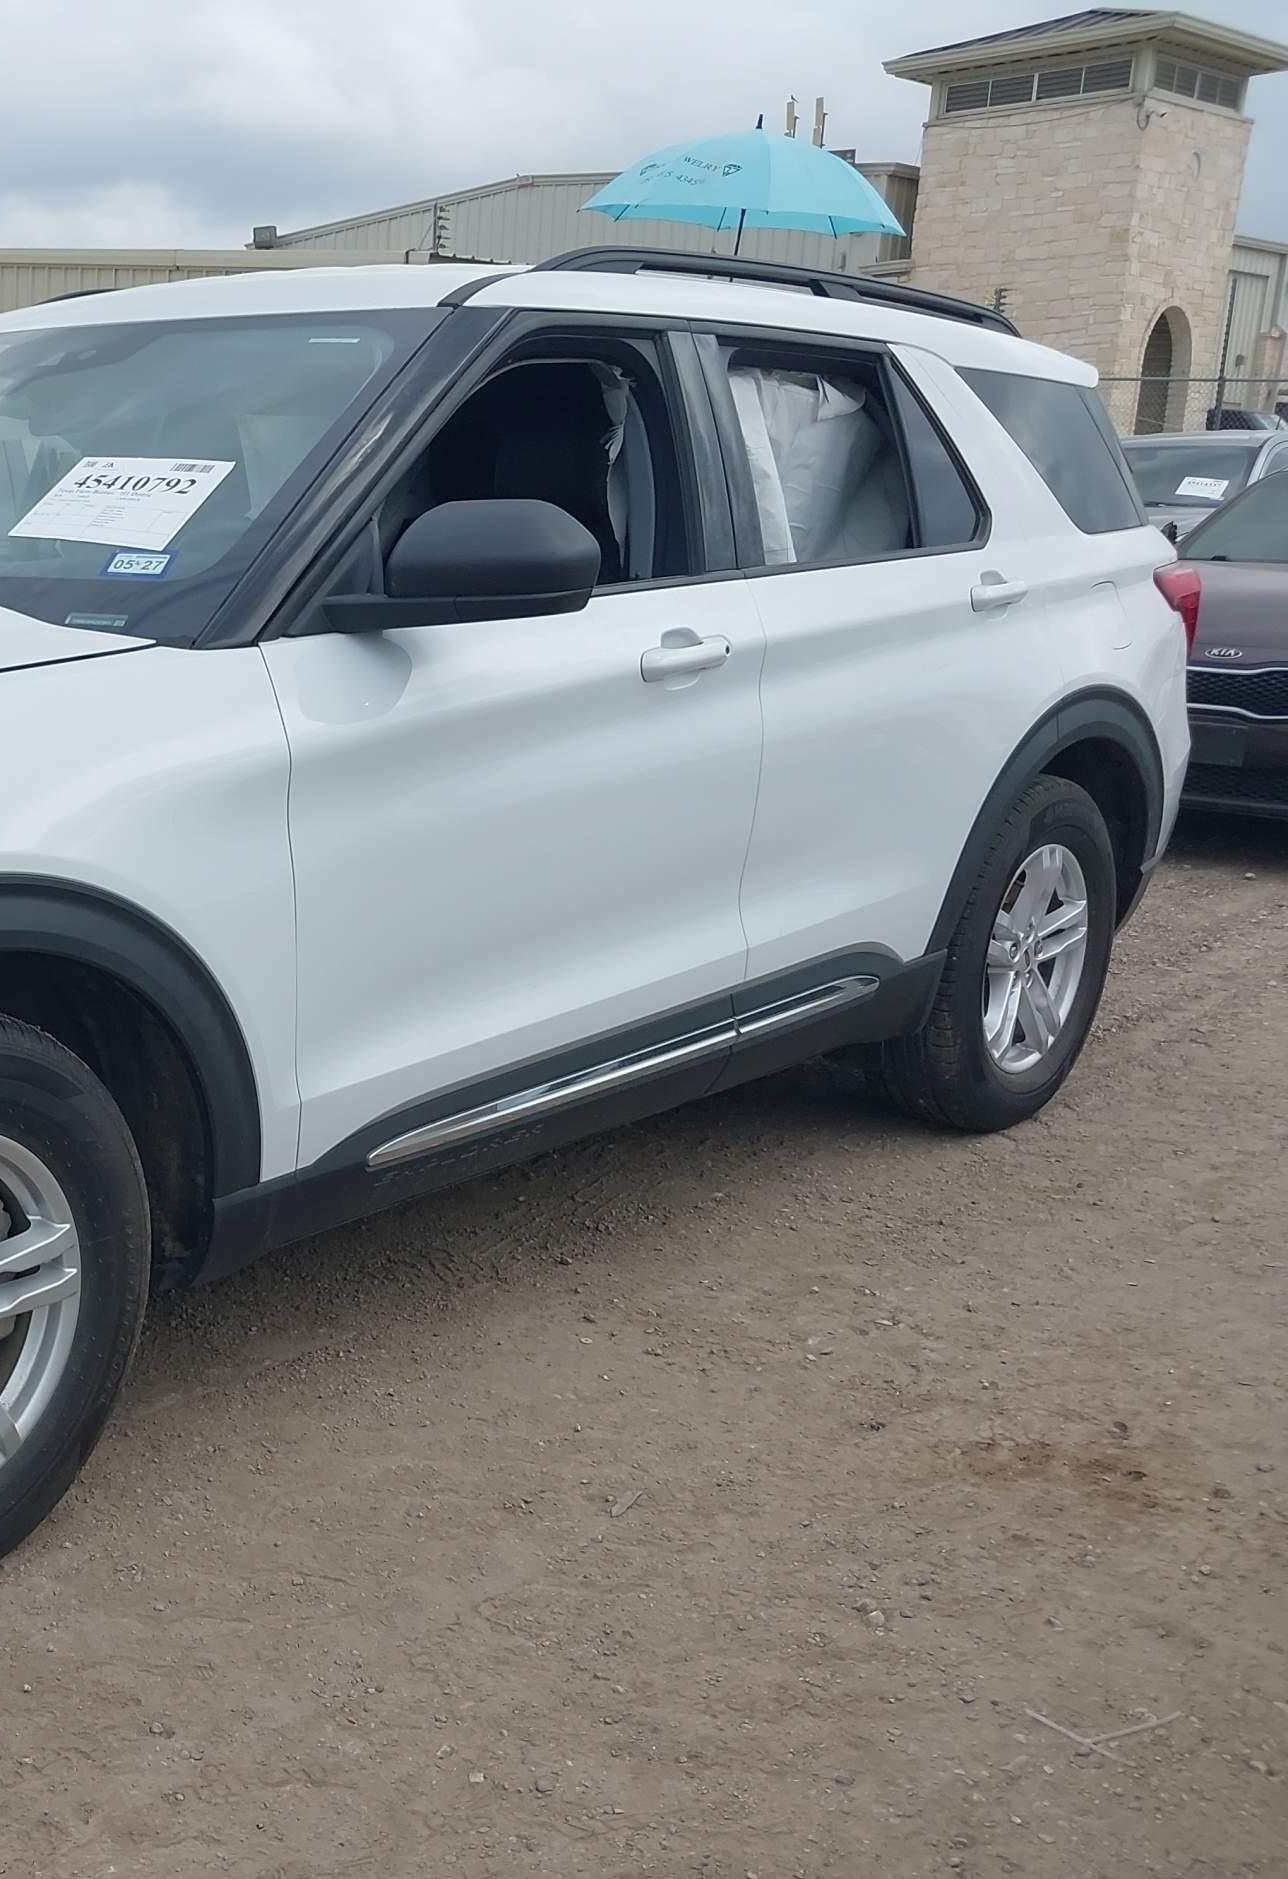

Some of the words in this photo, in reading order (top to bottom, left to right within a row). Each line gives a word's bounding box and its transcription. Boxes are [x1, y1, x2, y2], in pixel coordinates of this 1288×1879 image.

[74, 473, 198, 495] 45410792
[113, 559, 136, 570] 05
[140, 560, 165, 571] 27
